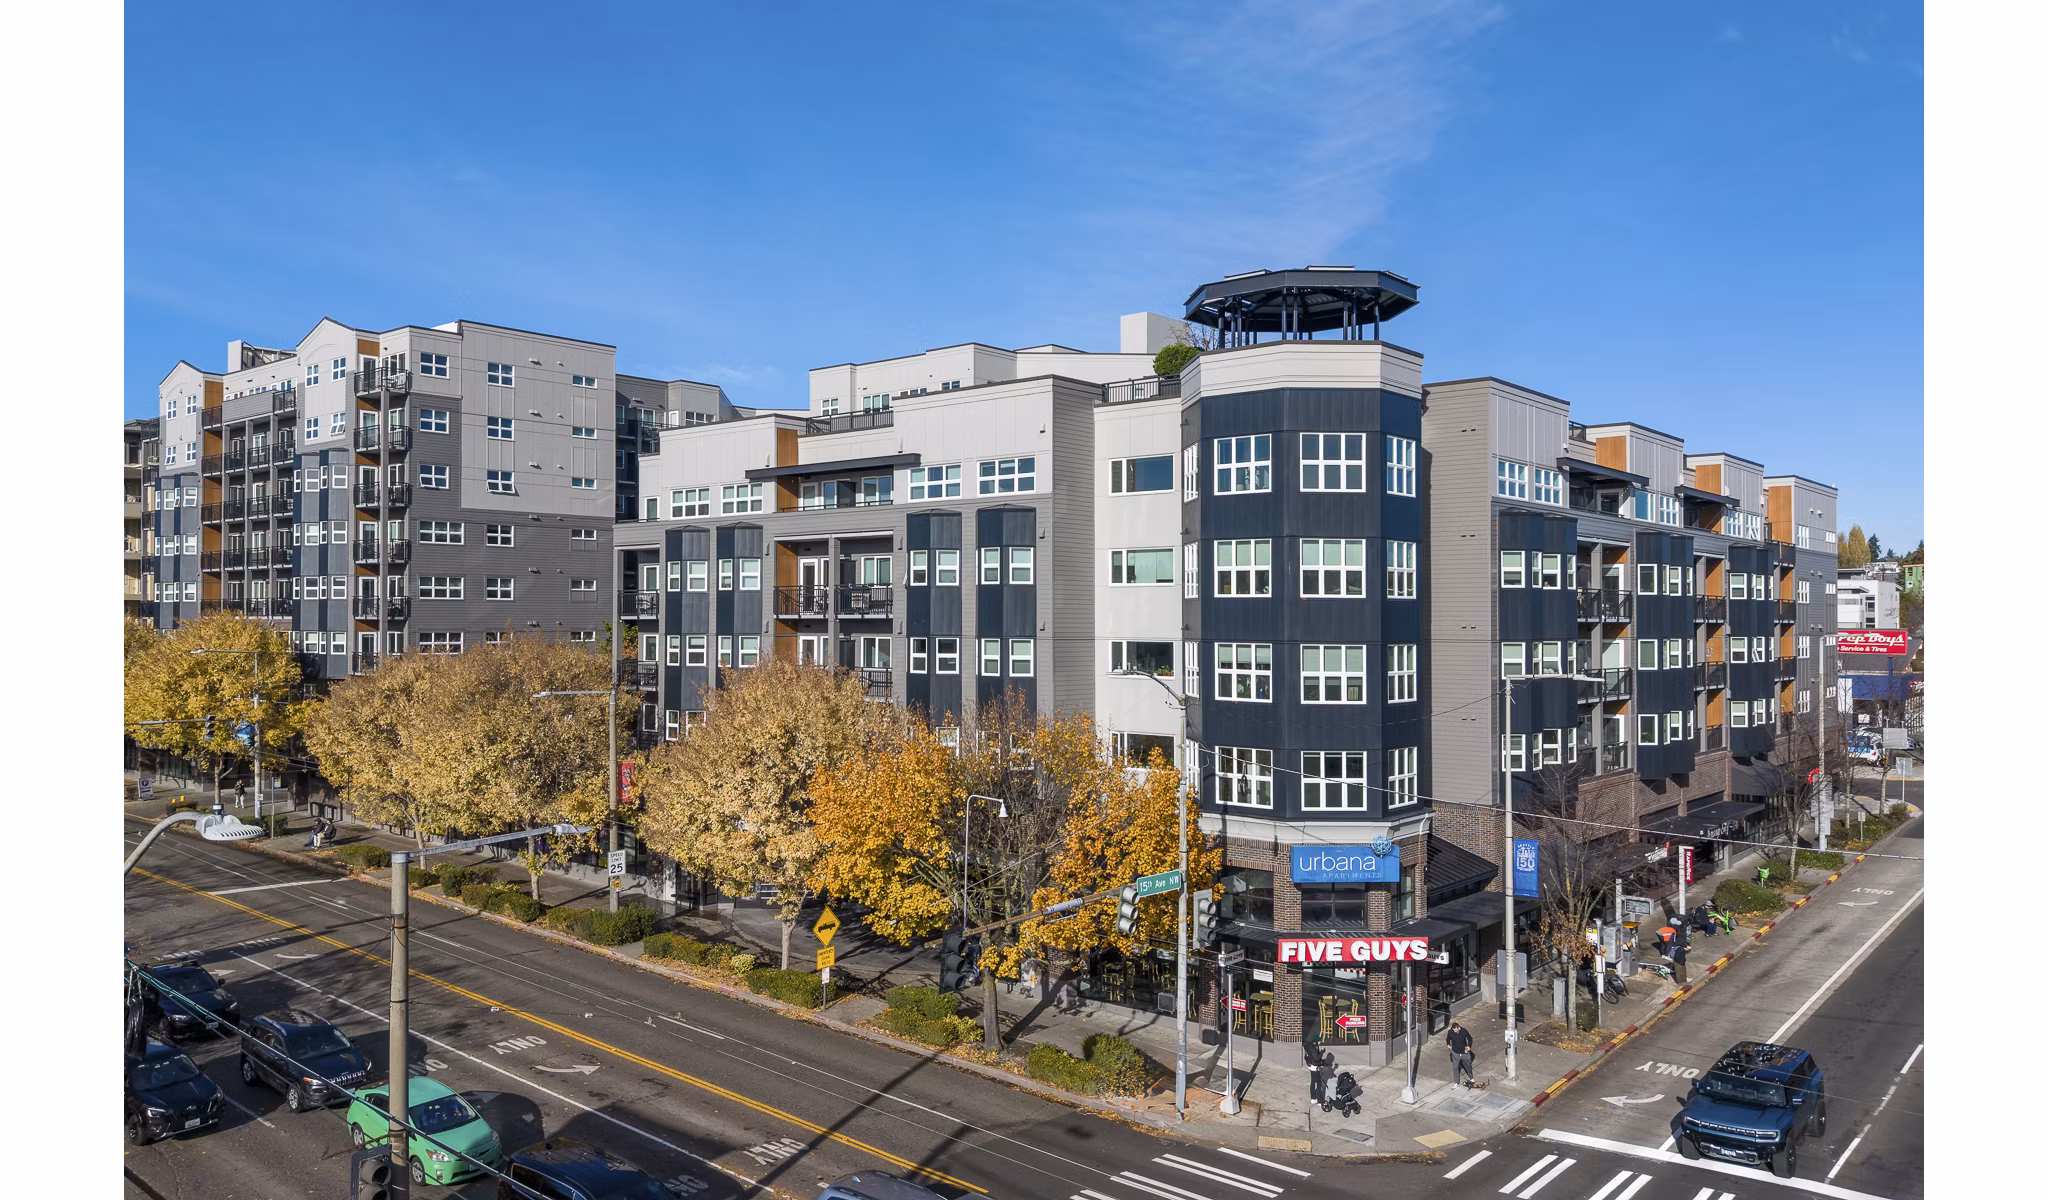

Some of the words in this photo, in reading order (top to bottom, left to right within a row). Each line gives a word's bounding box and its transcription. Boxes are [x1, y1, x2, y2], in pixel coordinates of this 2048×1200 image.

[1866, 632, 1905, 647] Boys
[610, 863, 623, 874] 25
[1300, 852, 1376, 871] urbana
[1140, 881, 1153, 892] 15th
[1155, 879, 1166, 889] Ave
[1169, 875, 1179, 886] NW
[1850, 887, 1895, 896] ONLY
[1281, 941, 1343, 962] FIVE
[1350, 939, 1428, 961] GUYS
[487, 1035, 547, 1055] ONLY
[1634, 1060, 1700, 1079] ONLY
[743, 1137, 809, 1165] ONLY
